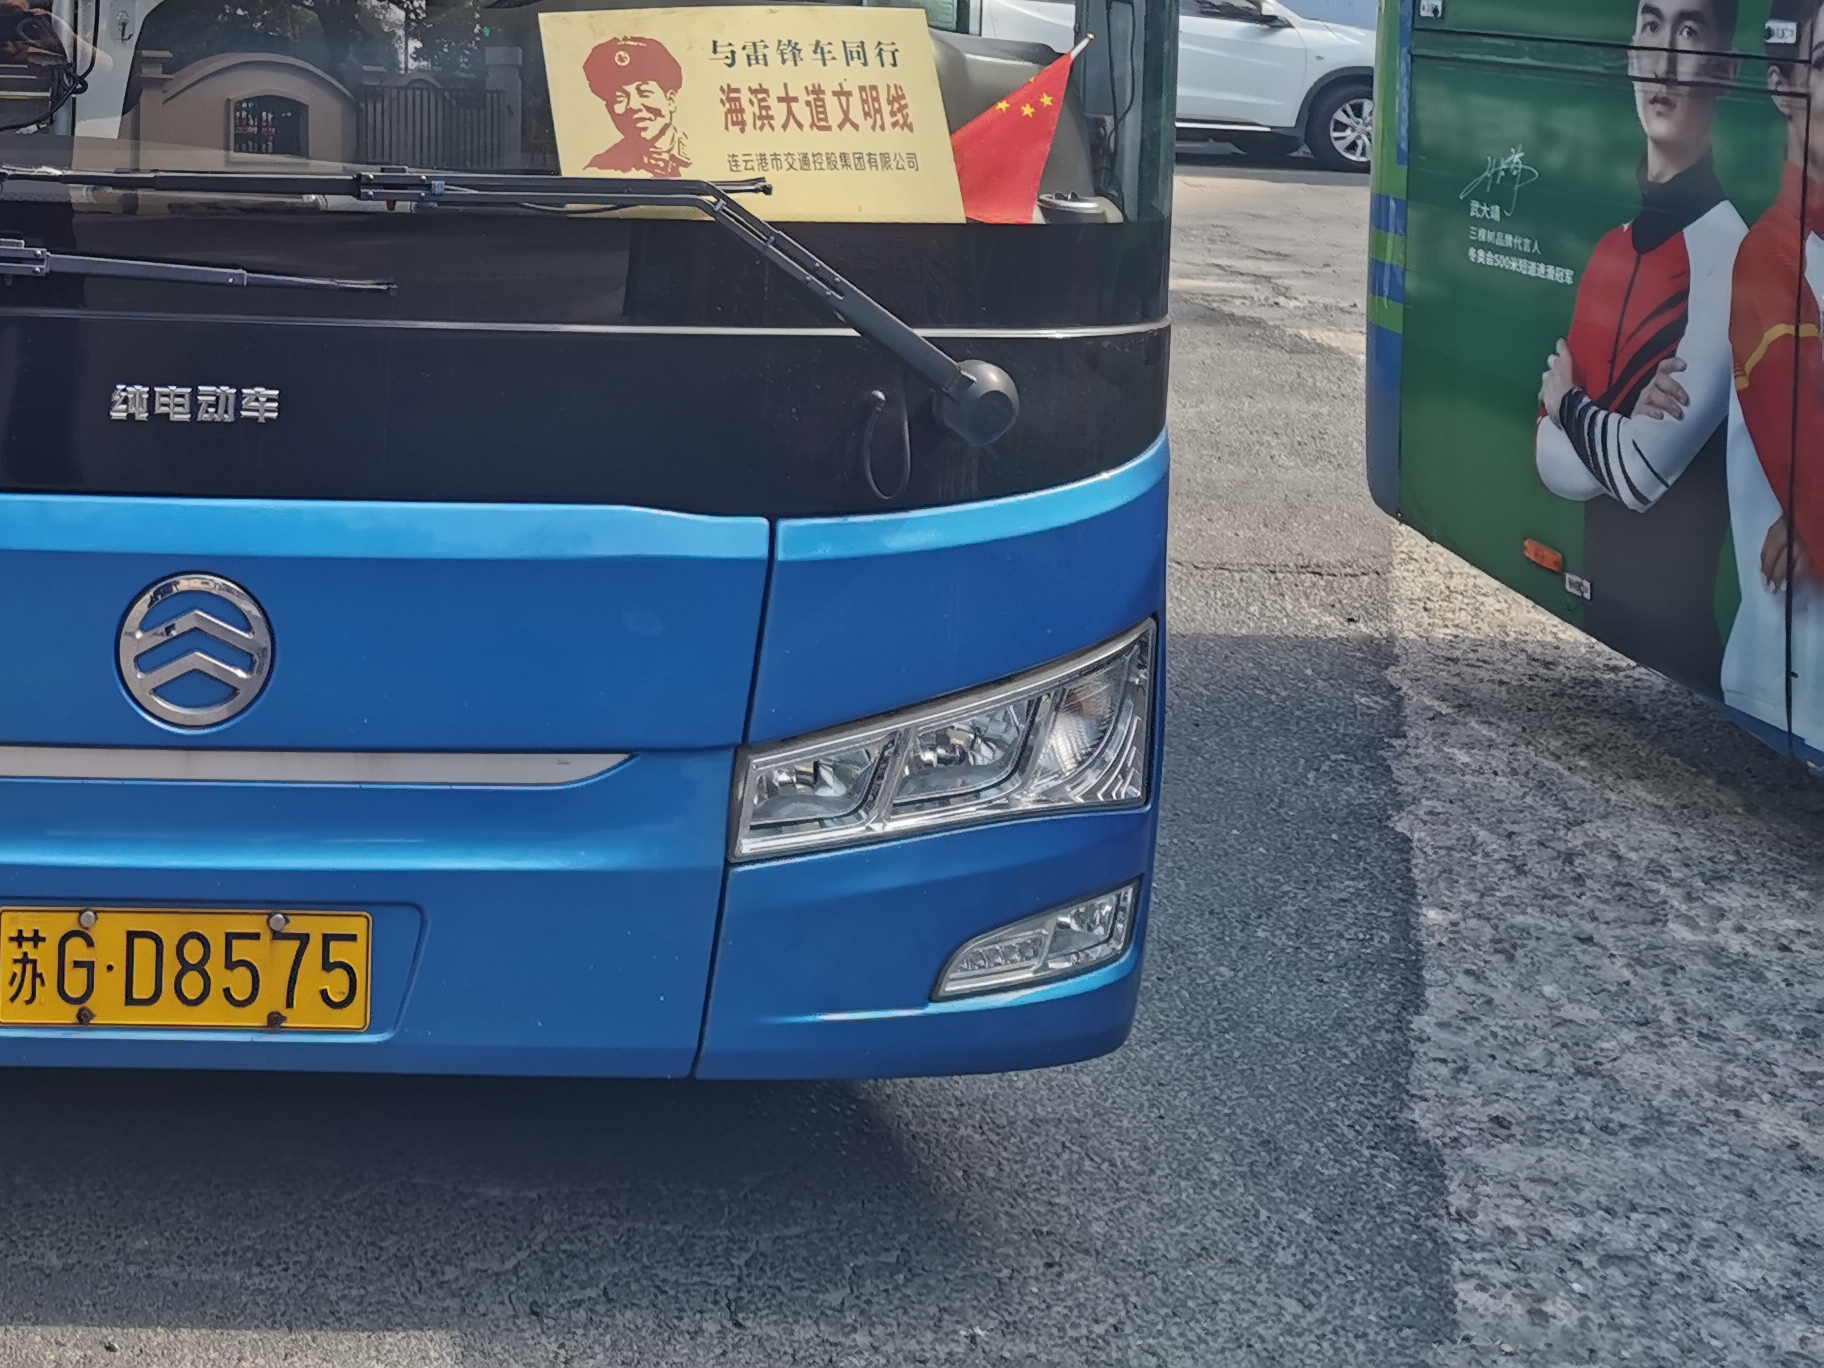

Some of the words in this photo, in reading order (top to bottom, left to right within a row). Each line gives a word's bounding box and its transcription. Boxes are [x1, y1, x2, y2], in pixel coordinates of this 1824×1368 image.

[709, 38, 900, 68] 与雷锋车同行
[719, 82, 914, 134] 海滨大道文明线
[727, 151, 920, 173] 连云港市交通控股集团有限公司
[109, 384, 280, 423] 纯电动车
